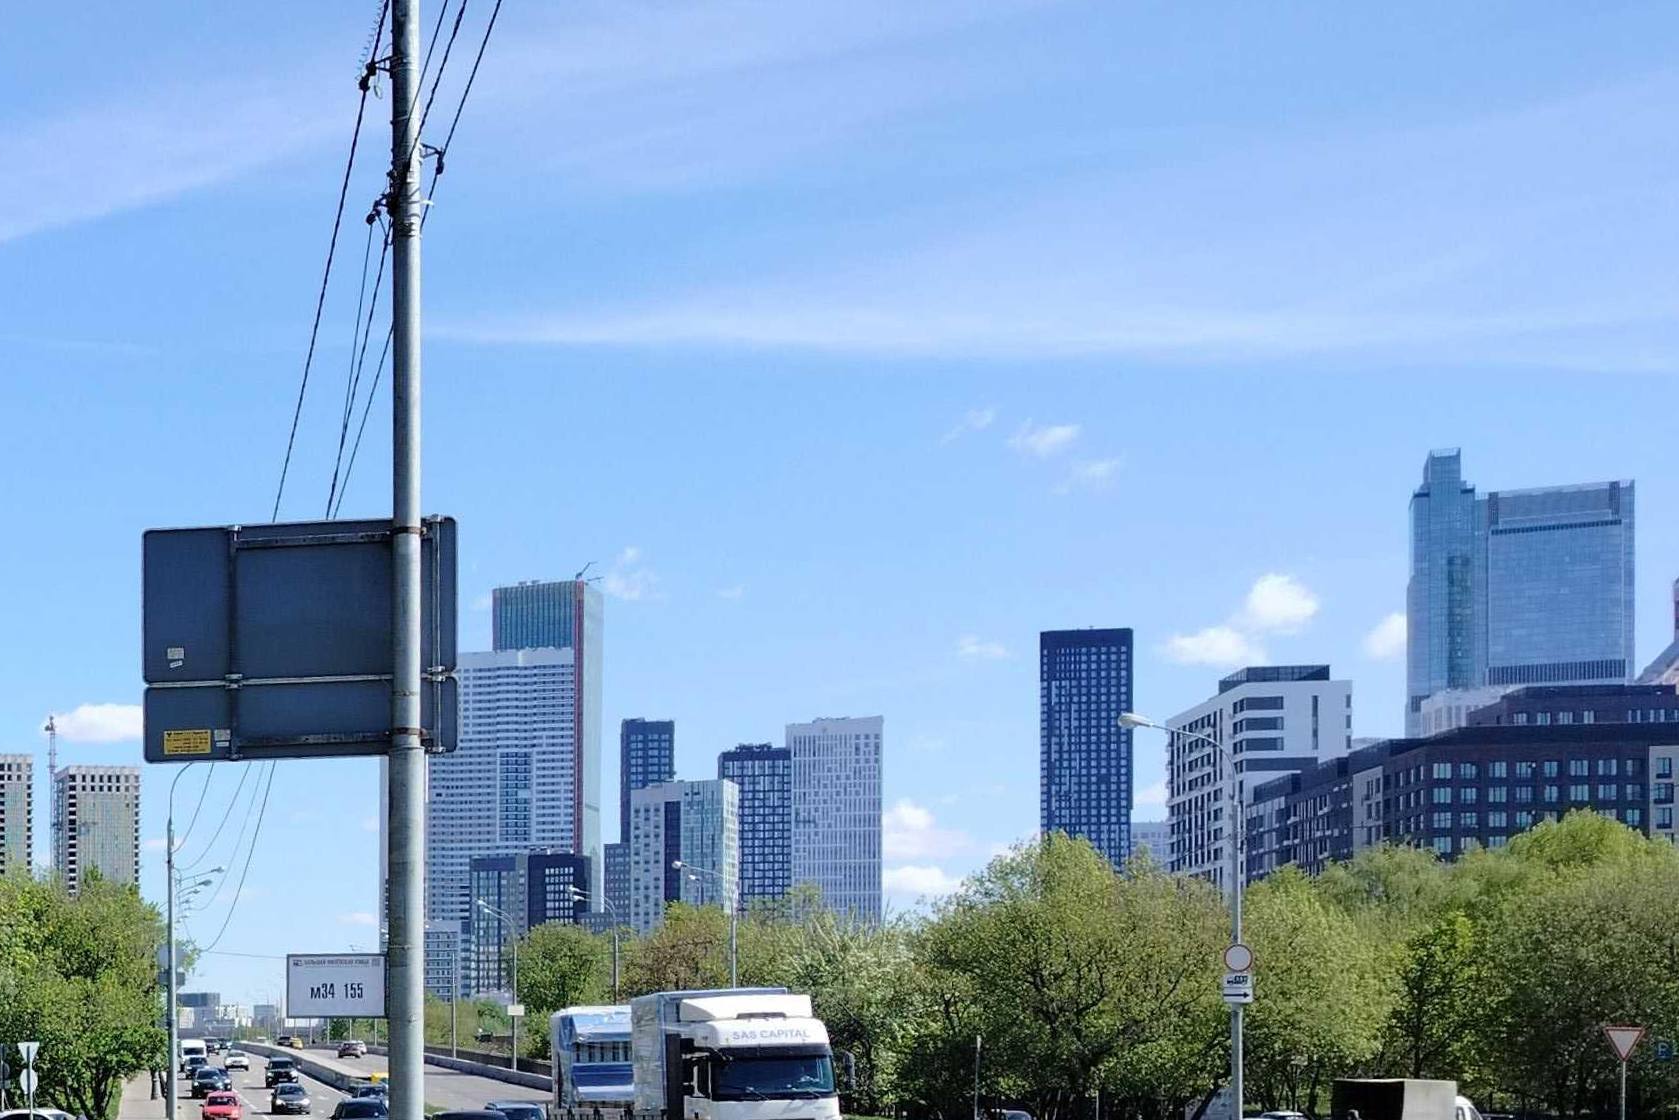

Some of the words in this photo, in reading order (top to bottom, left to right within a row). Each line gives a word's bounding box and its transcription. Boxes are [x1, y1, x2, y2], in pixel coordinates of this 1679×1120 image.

[343, 982, 364, 1000] 155
[731, 1030, 758, 1041] SAS
[760, 1028, 811, 1039] CAPITAL
